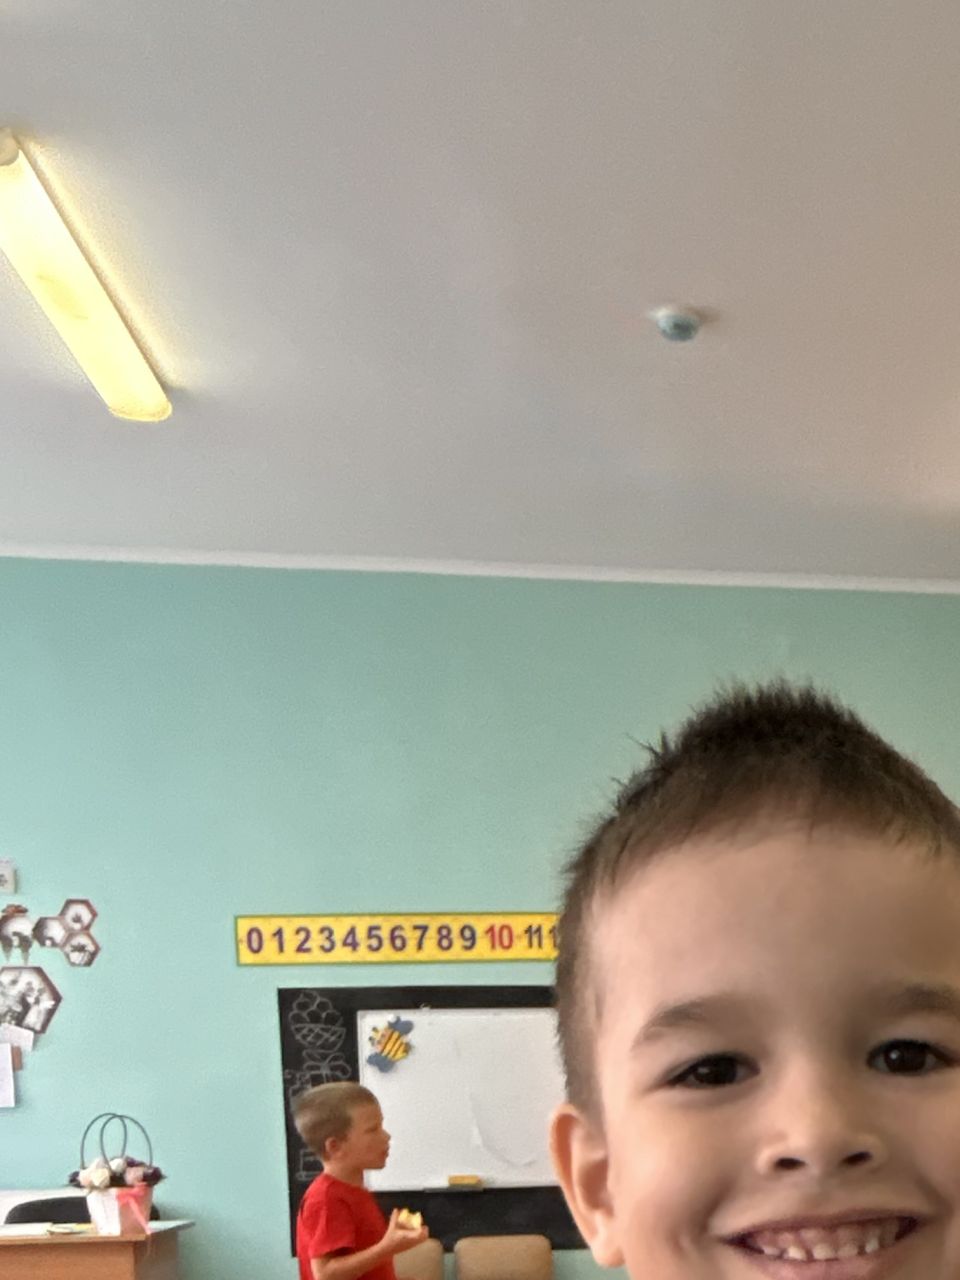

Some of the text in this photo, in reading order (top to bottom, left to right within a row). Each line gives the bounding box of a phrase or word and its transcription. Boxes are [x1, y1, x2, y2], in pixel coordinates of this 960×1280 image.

[246, 926, 264, 954] 0
[271, 926, 285, 953] 1
[295, 926, 312, 953] 2
[319, 925, 336, 953] 3
[342, 925, 360, 952] 4
[366, 925, 383, 952] 5
[389, 924, 407, 952] 6
[412, 924, 429, 952] 7
[436, 924, 453, 951] 8
[459, 924, 476, 951] 9
[484, 924, 514, 951] 10
[523, 924, 543, 950] 11
